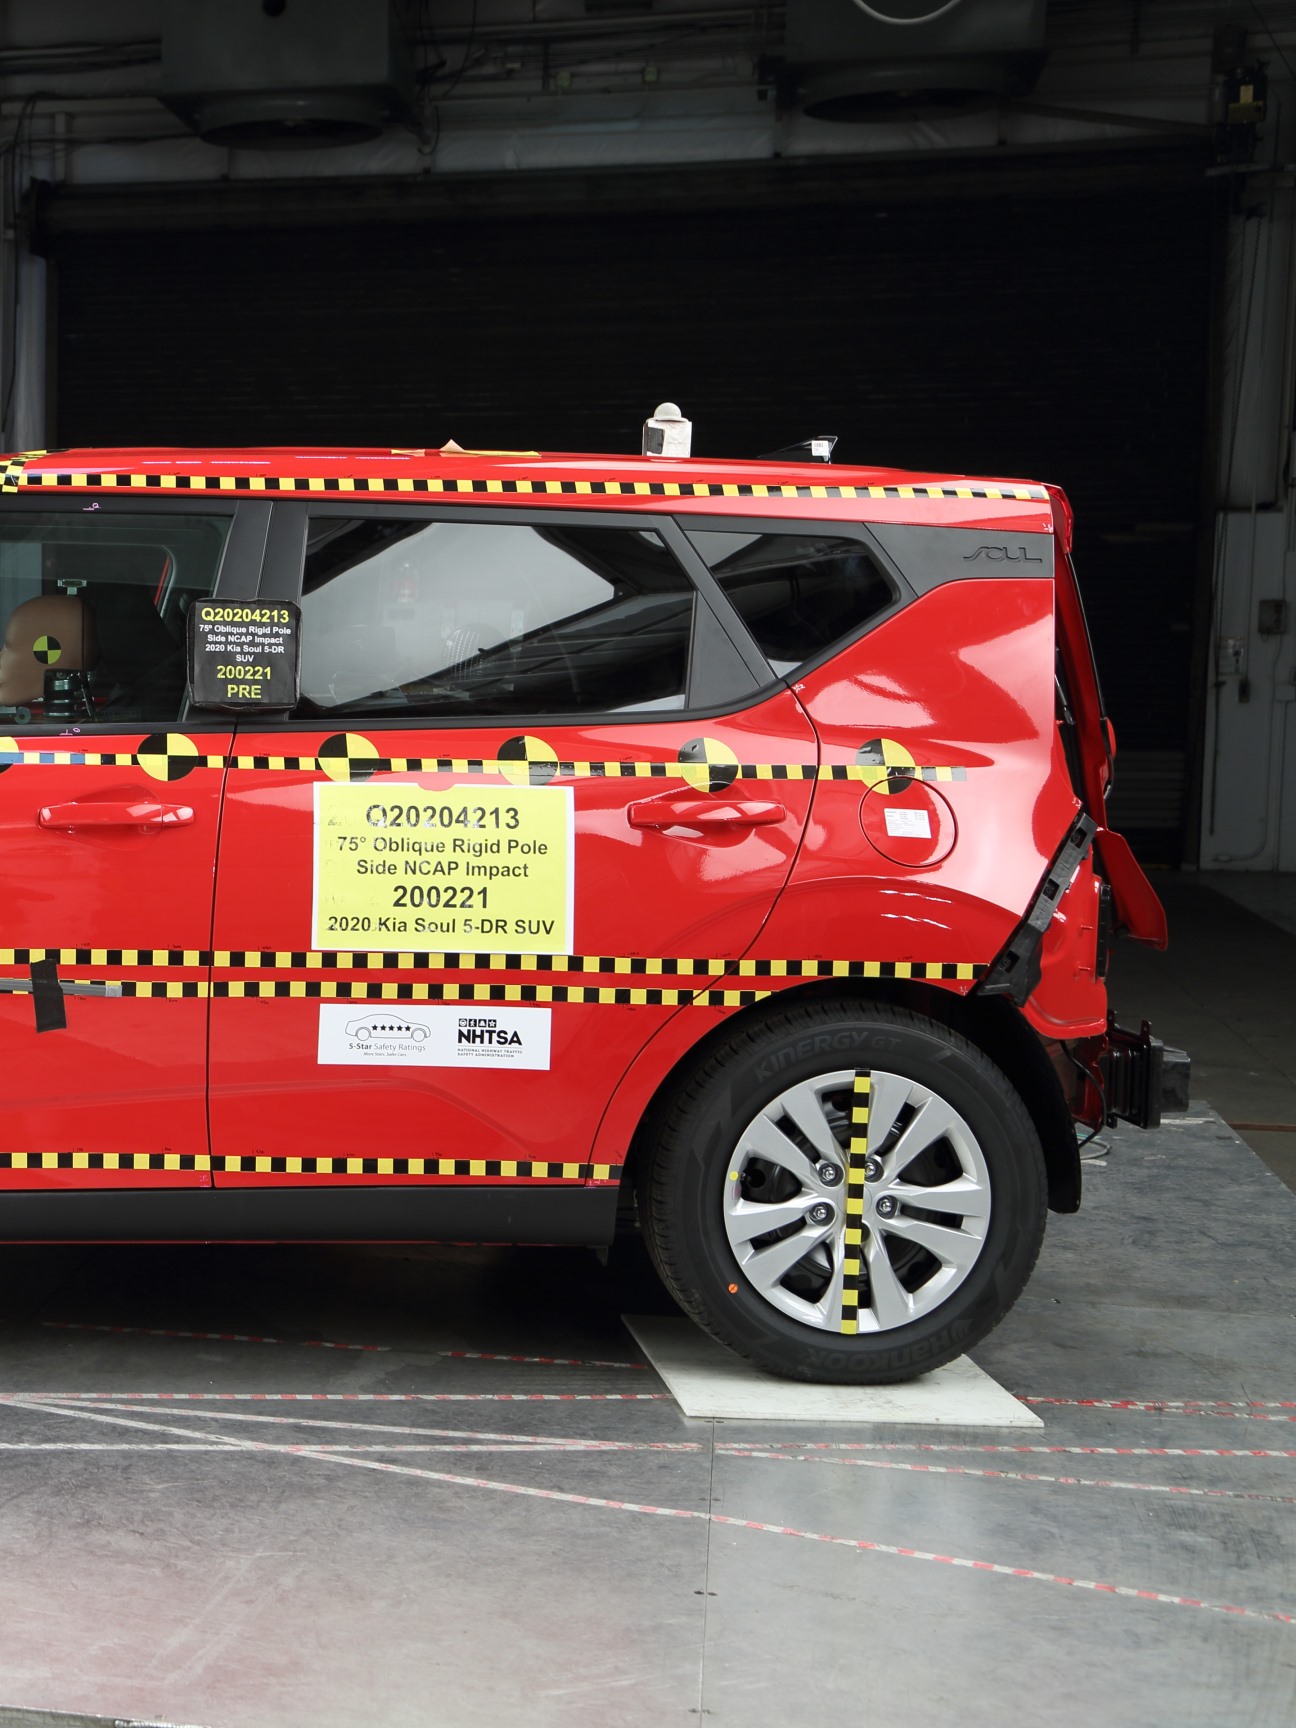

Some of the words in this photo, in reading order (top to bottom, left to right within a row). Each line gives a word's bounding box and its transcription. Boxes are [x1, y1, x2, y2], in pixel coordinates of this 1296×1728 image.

[962, 546, 1043, 563] SOUL
[201, 607, 289, 623] Q20204213
[214, 624, 247, 634] Oblique
[248, 626, 271, 635] Rigid
[272, 626, 291, 635] Pole
[207, 634, 226, 642] Side
[227, 635, 253, 643] NCAP
[255, 635, 283, 645] Impact
[205, 643, 225, 652] 2020
[227, 644, 241, 652] Kia
[243, 645, 262, 653] Soul
[264, 645, 285, 654] 5-DR
[235, 654, 255, 662] SUV
[216, 665, 271, 680] 200221
[227, 684, 262, 699] PRE
[365, 804, 520, 830] Q20204213
[372, 836, 446, 857] Oblique
[452, 838, 500, 858] Rigid
[507, 839, 548, 855] Pole
[356, 859, 398, 875] Side
[404, 860, 459, 876] NCAP
[466, 861, 529, 880] Impact
[392, 884, 488, 909] 200221
[327, 916, 372, 932] 2020
[378, 917, 408, 932] Kia
[414, 917, 456, 933] Soul
[463, 918, 508, 934] 5-DR
[514, 919, 555, 935] SUV
[457, 1028, 523, 1046] NHTSA
[348, 1042, 373, 1050] 5-Star
[374, 1042, 397, 1052] Safety
[398, 1043, 426, 1053] Ratings
[752, 1031, 869, 1083] KINERGY
